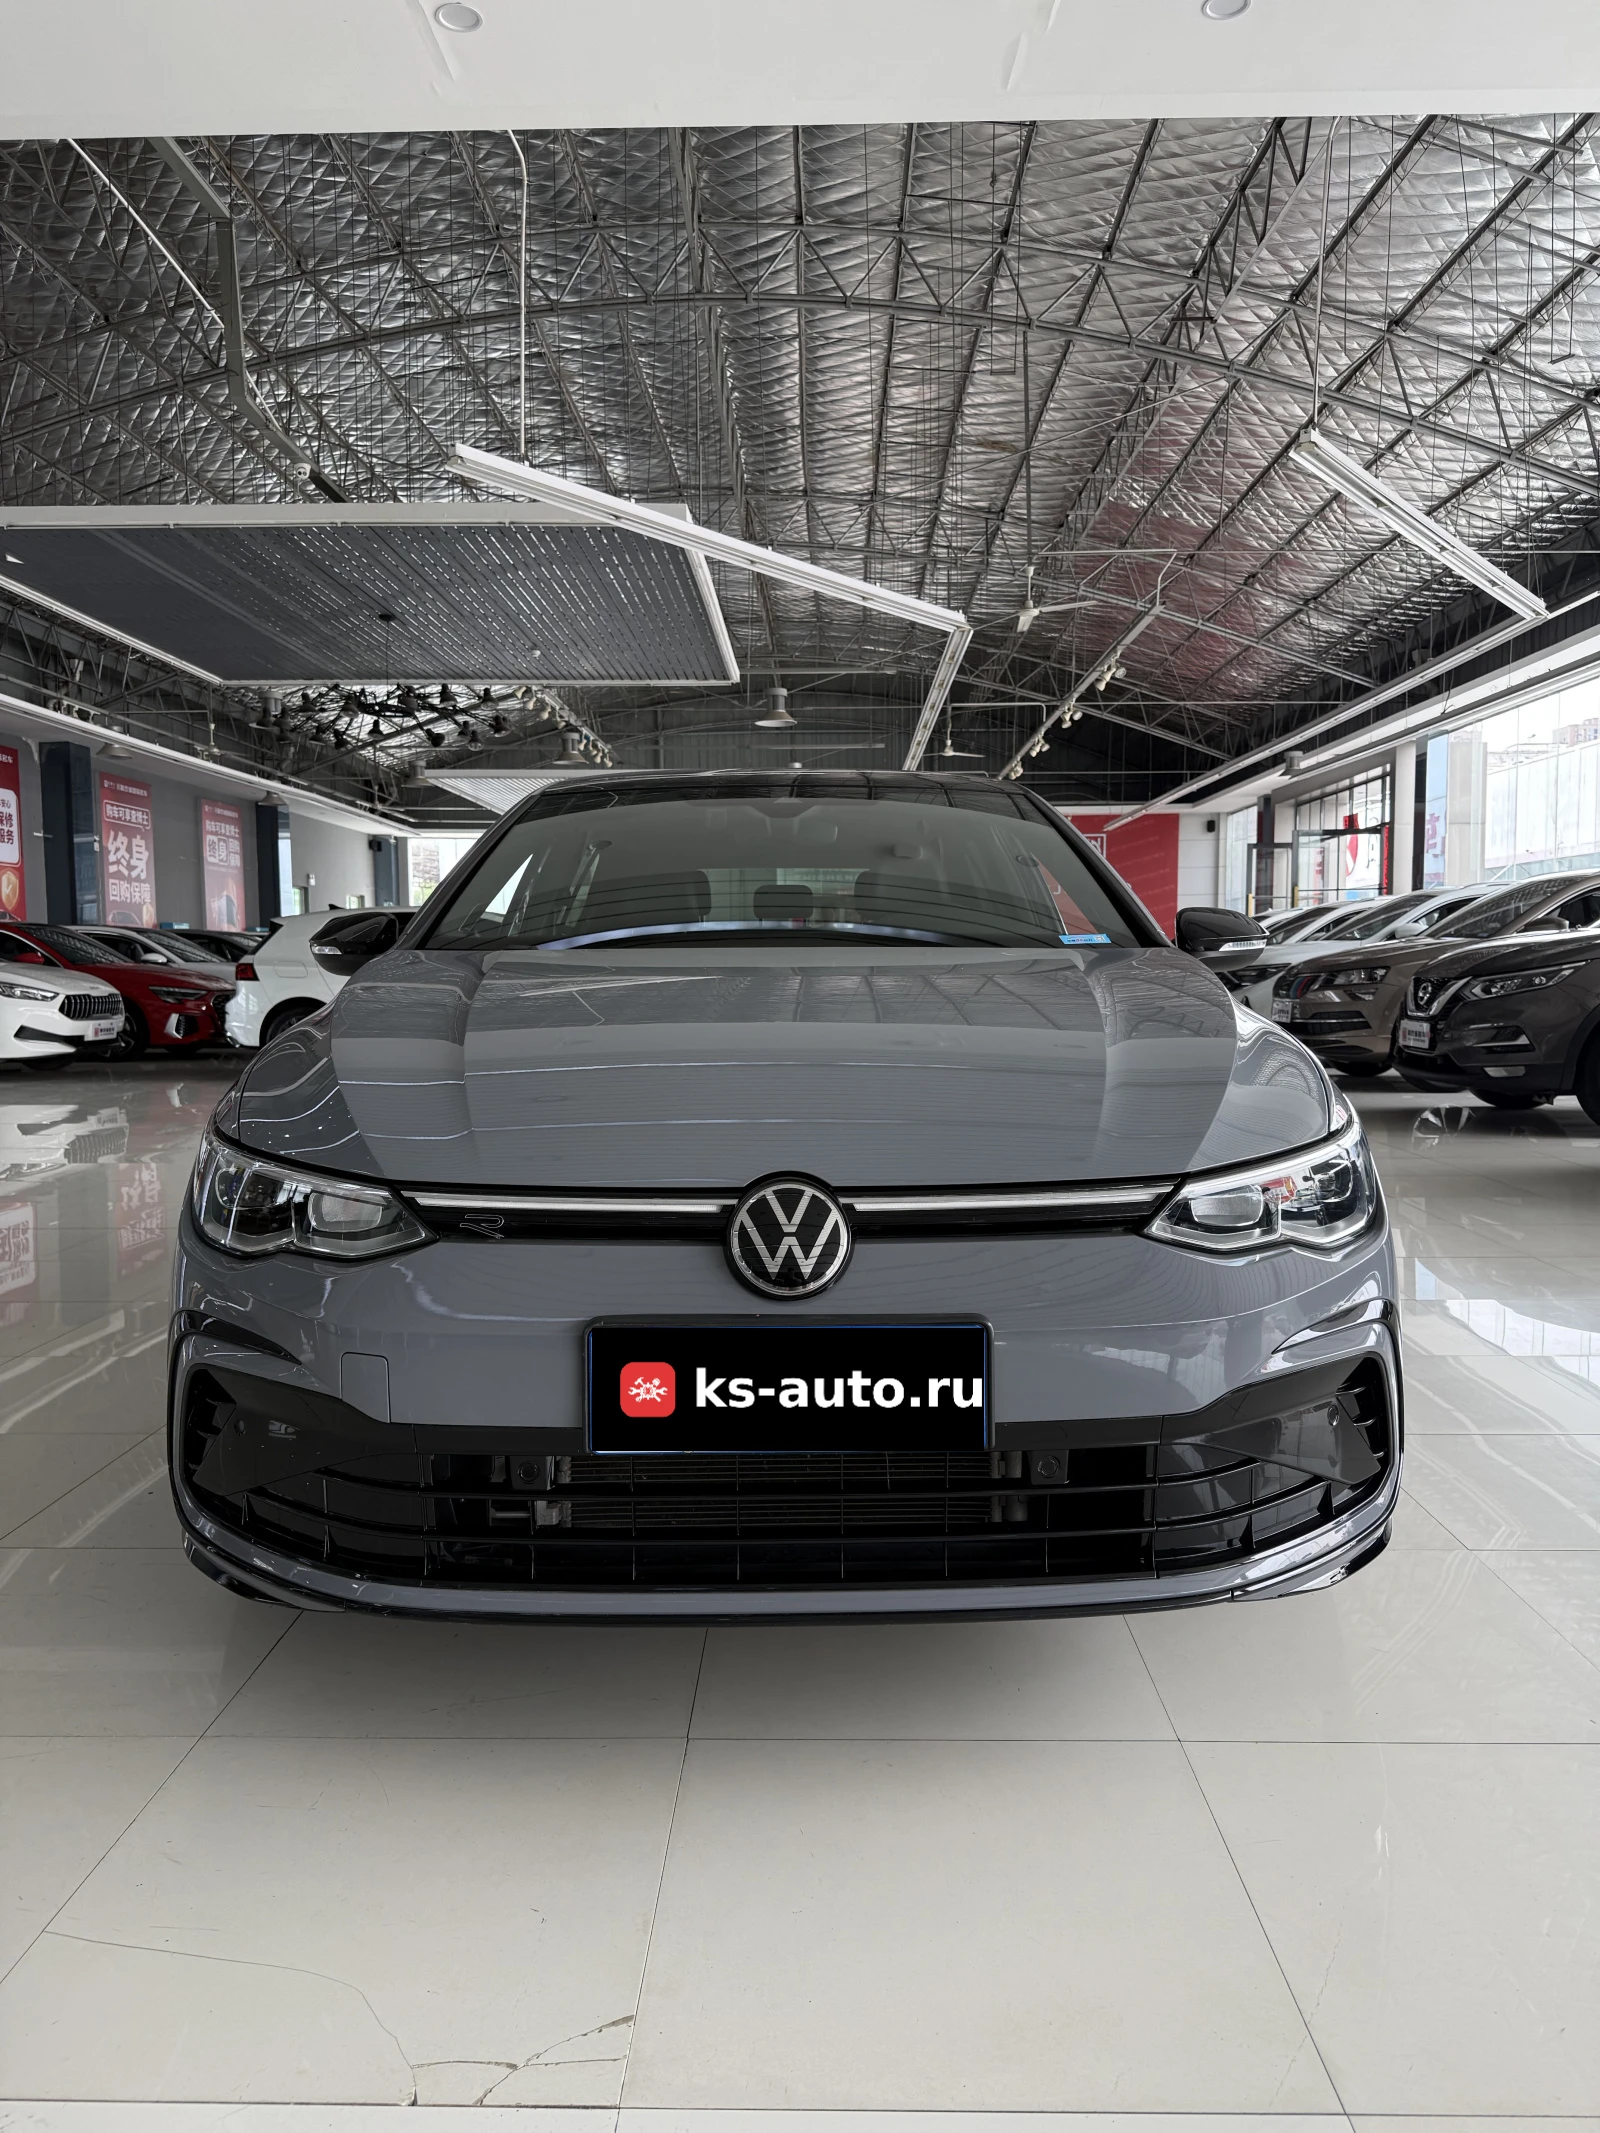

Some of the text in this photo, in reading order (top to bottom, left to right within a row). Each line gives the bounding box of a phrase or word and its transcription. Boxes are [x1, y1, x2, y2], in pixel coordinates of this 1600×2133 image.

[108, 829, 149, 879] 终身
[108, 878, 152, 905] 回购保障
